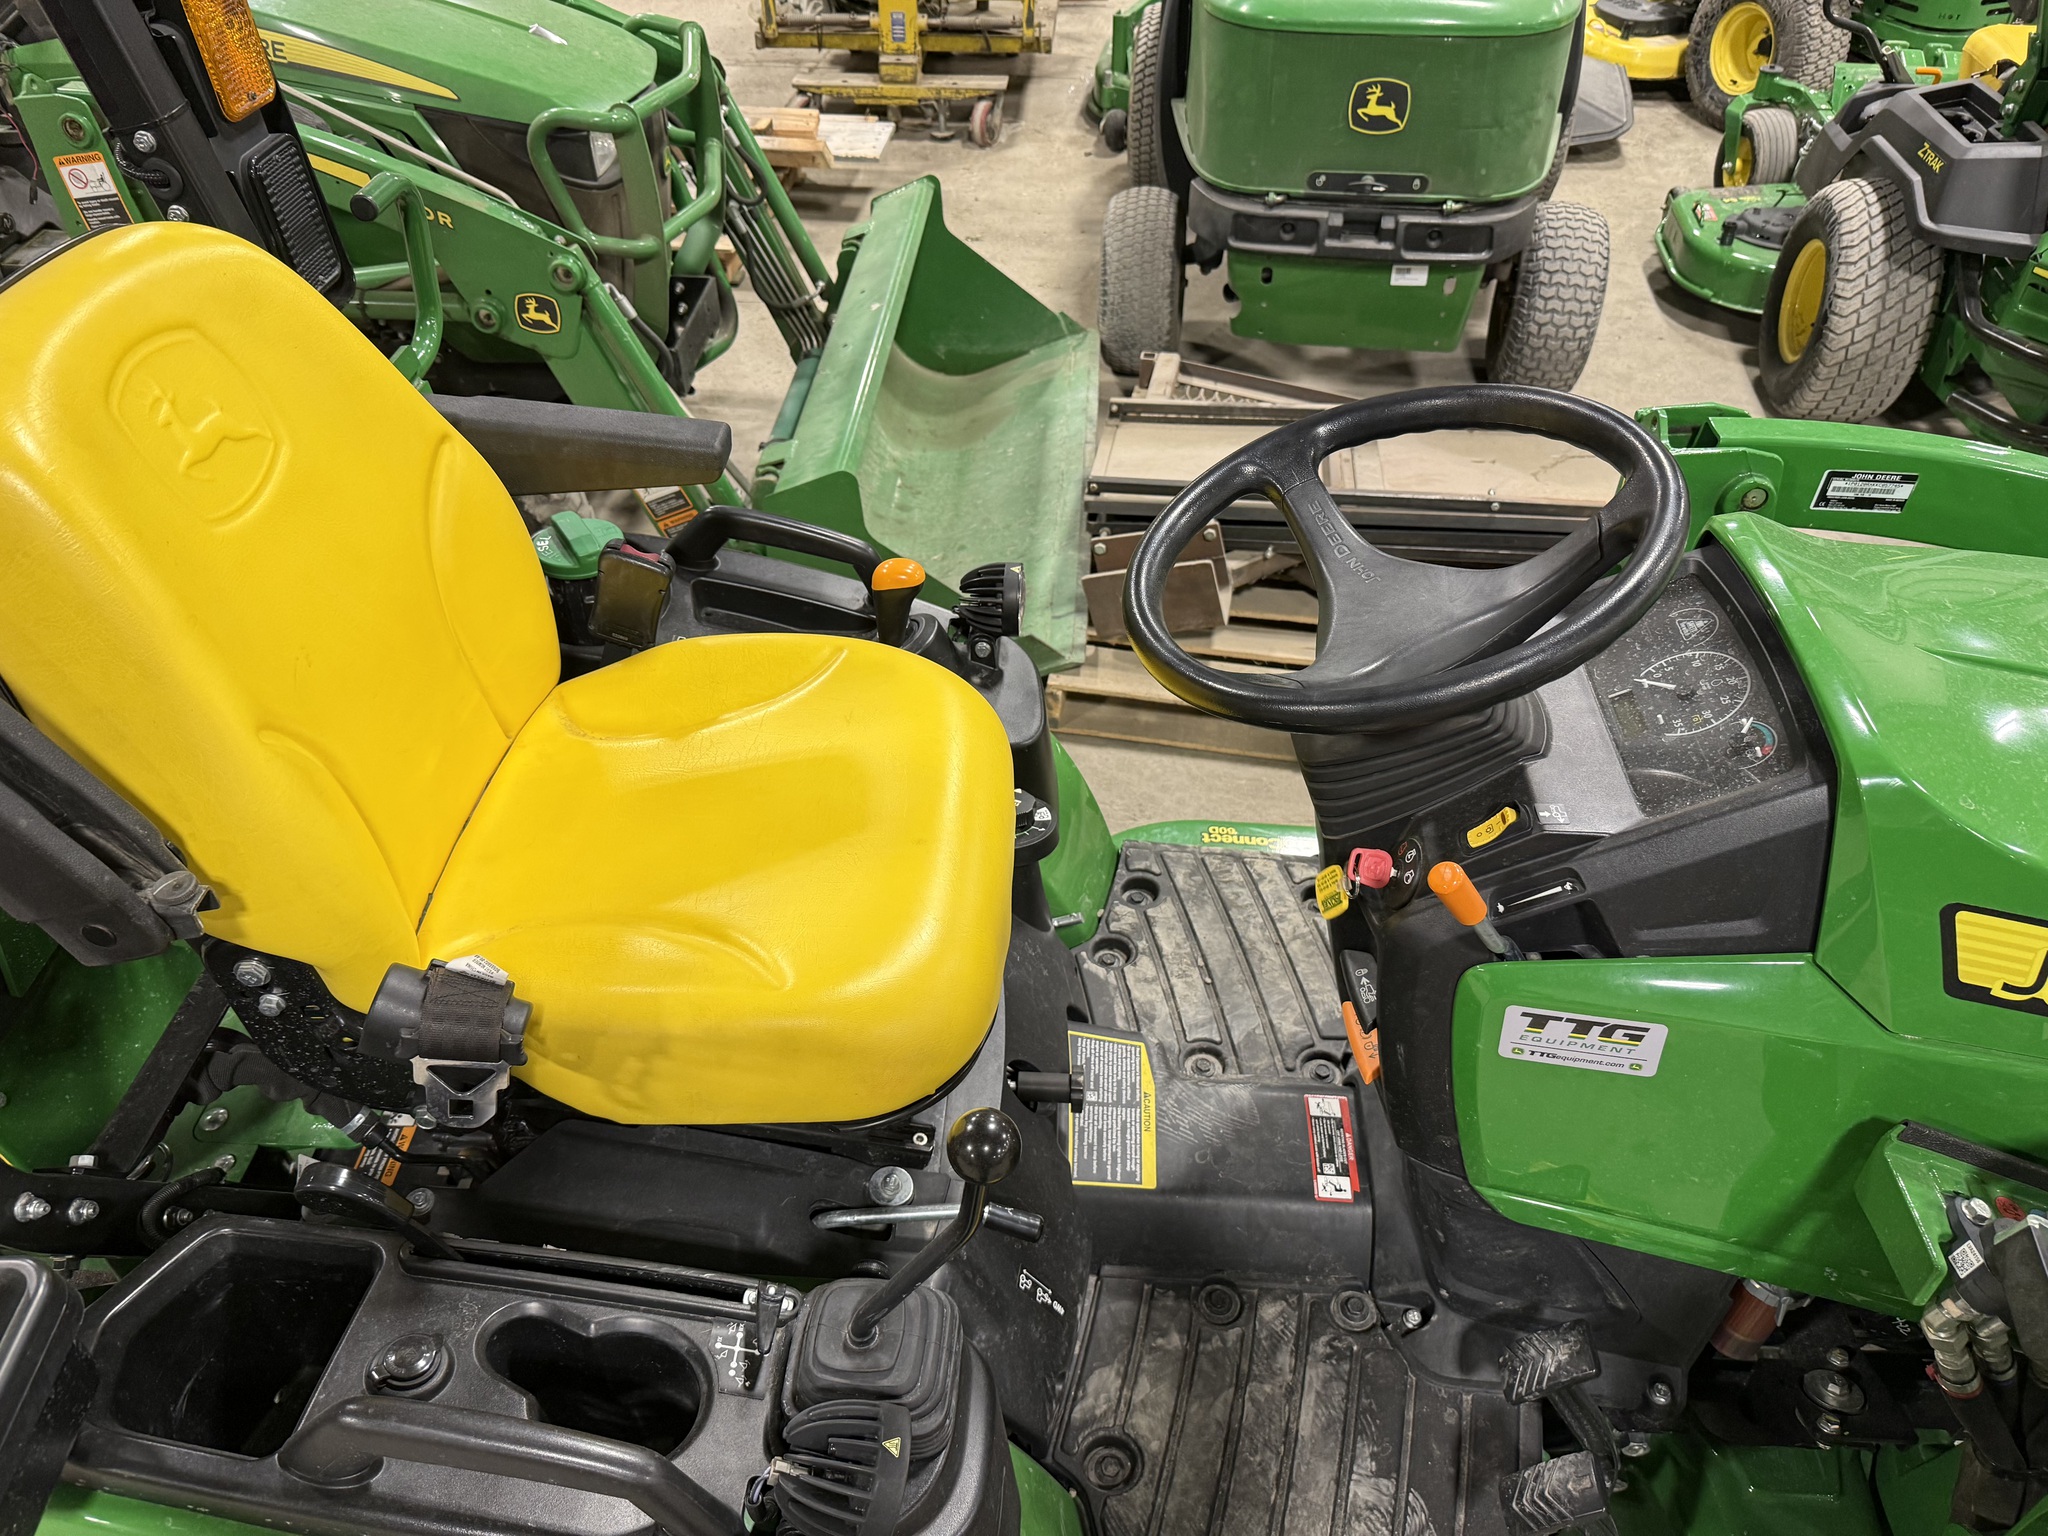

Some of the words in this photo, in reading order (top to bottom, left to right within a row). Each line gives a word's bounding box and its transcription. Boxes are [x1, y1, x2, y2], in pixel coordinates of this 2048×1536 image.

[63, 153, 101, 165] WARNING
[1917, 141, 1944, 173] ZTRAK
[1308, 500, 1351, 558] DEERE
[1345, 557, 1381, 584] JOHN
[1519, 1011, 1651, 1047] TTG
[1519, 1034, 1637, 1055] EQUIPMENT
[1528, 1049, 1625, 1069] TTGequipment.com
[1143, 1098, 1152, 1132] CAUTION
[1346, 1137, 1354, 1161] DANGER
